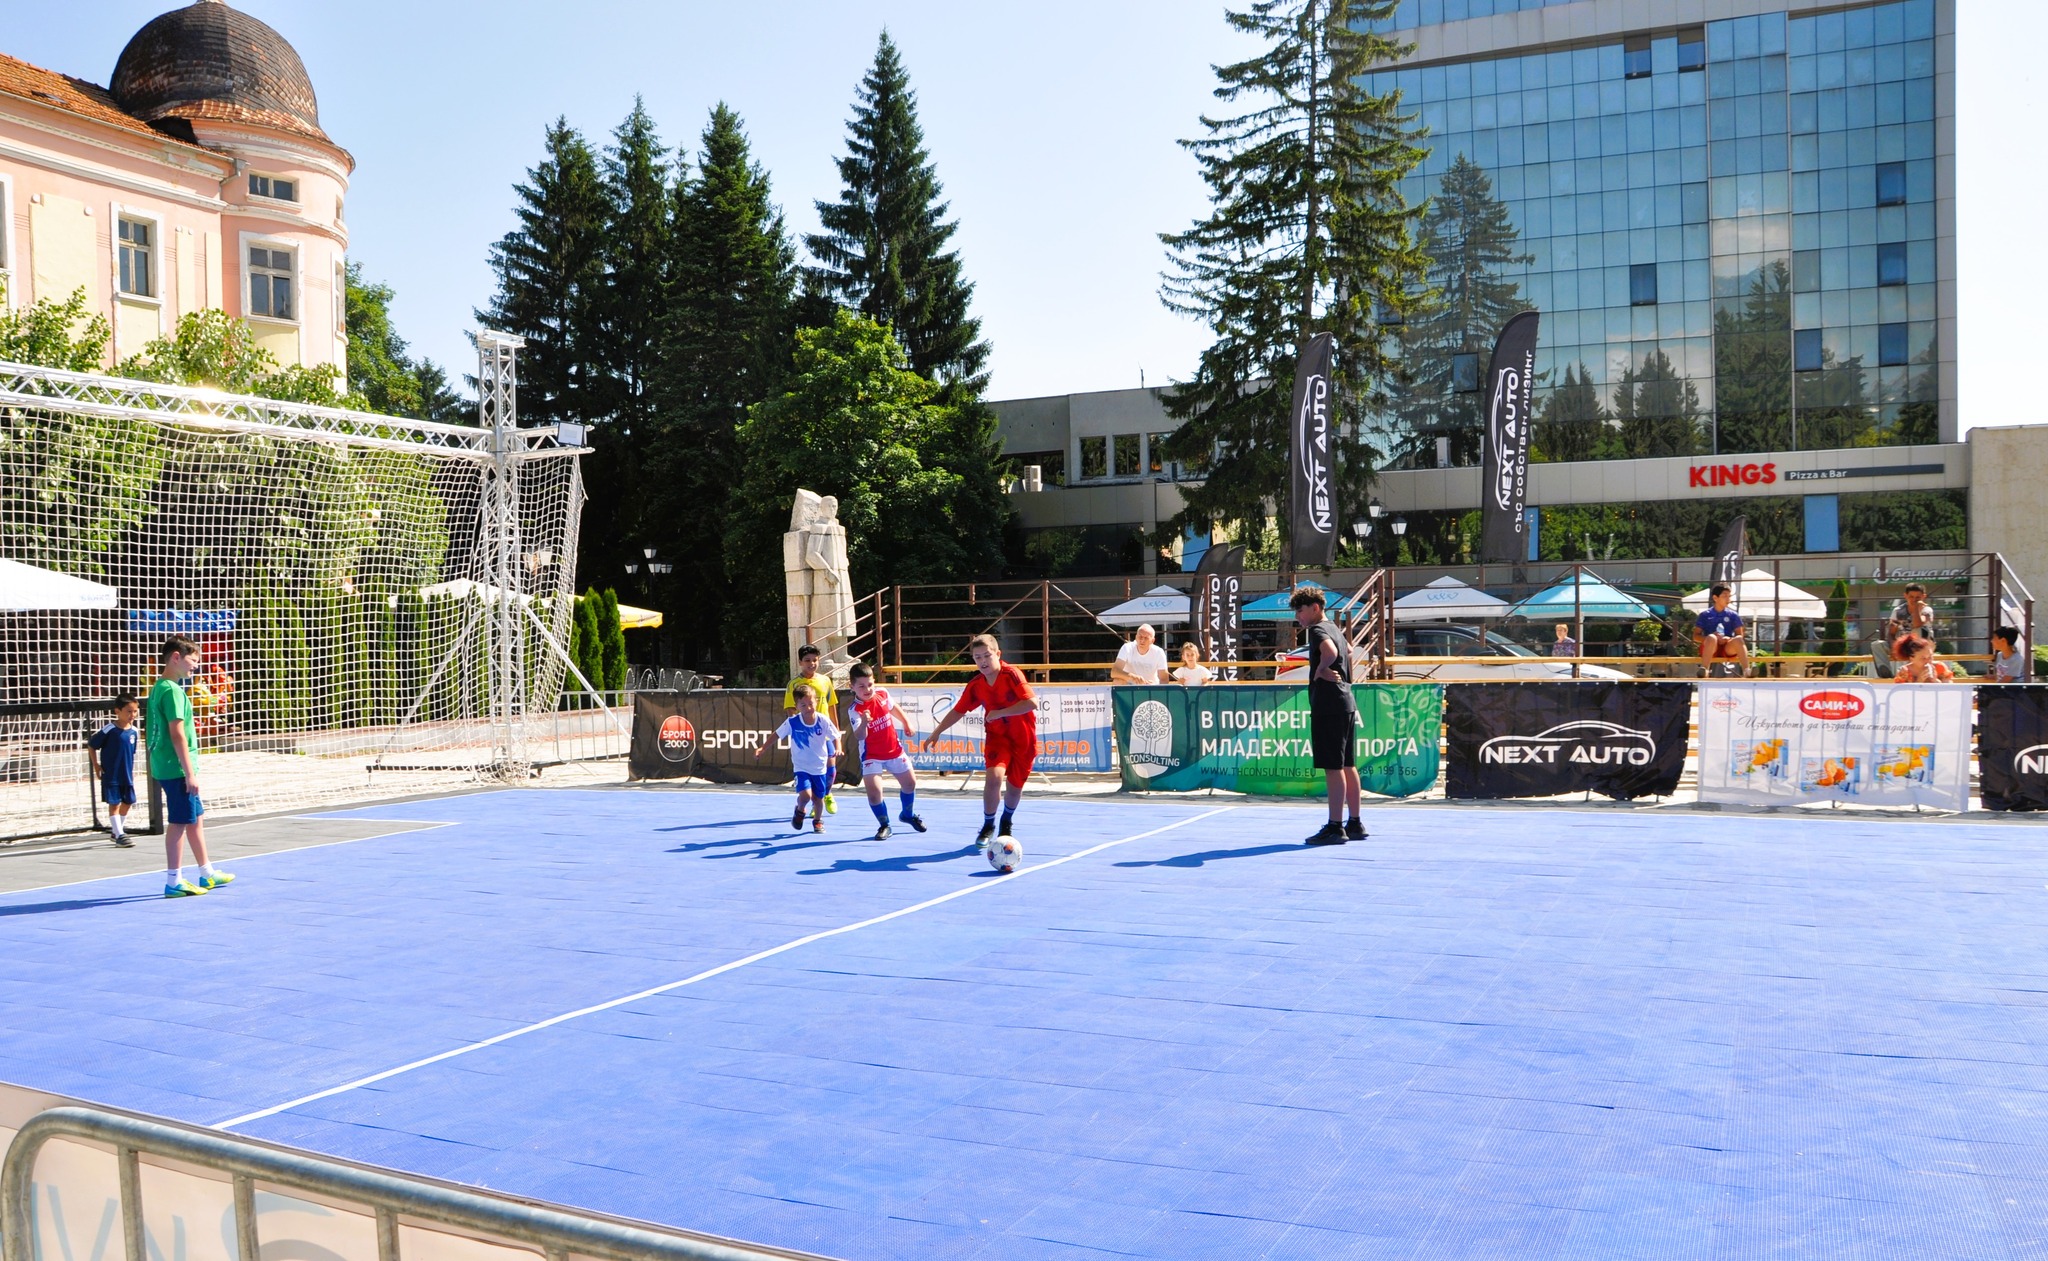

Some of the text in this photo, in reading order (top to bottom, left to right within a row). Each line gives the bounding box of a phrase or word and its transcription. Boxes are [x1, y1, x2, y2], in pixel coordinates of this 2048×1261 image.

[1501, 372, 1518, 506] NEXT AUTO
[1313, 379, 1332, 528] NEXT AUTO
[1690, 463, 1776, 488] KINGS
[1790, 471, 1819, 479] Pizza
[1829, 469, 1848, 478] Bar
[1210, 577, 1220, 630] AUTO
[1227, 579, 1239, 681] NEXT AUTO
[1804, 700, 1859, 711] САМИ-М
[1201, 711, 1213, 729] В
[662, 730, 692, 740] SPORT
[664, 740, 689, 749] 2000
[701, 730, 772, 749] SPORT
[1036, 740, 1091, 755] ЕСТВО
[1201, 737, 1419, 759] МЛАДЕЖТА ПОРТА
[1485, 745, 1650, 766] NEXT AUTO
[1039, 756, 1091, 765] СПЕДИЦИЯ
